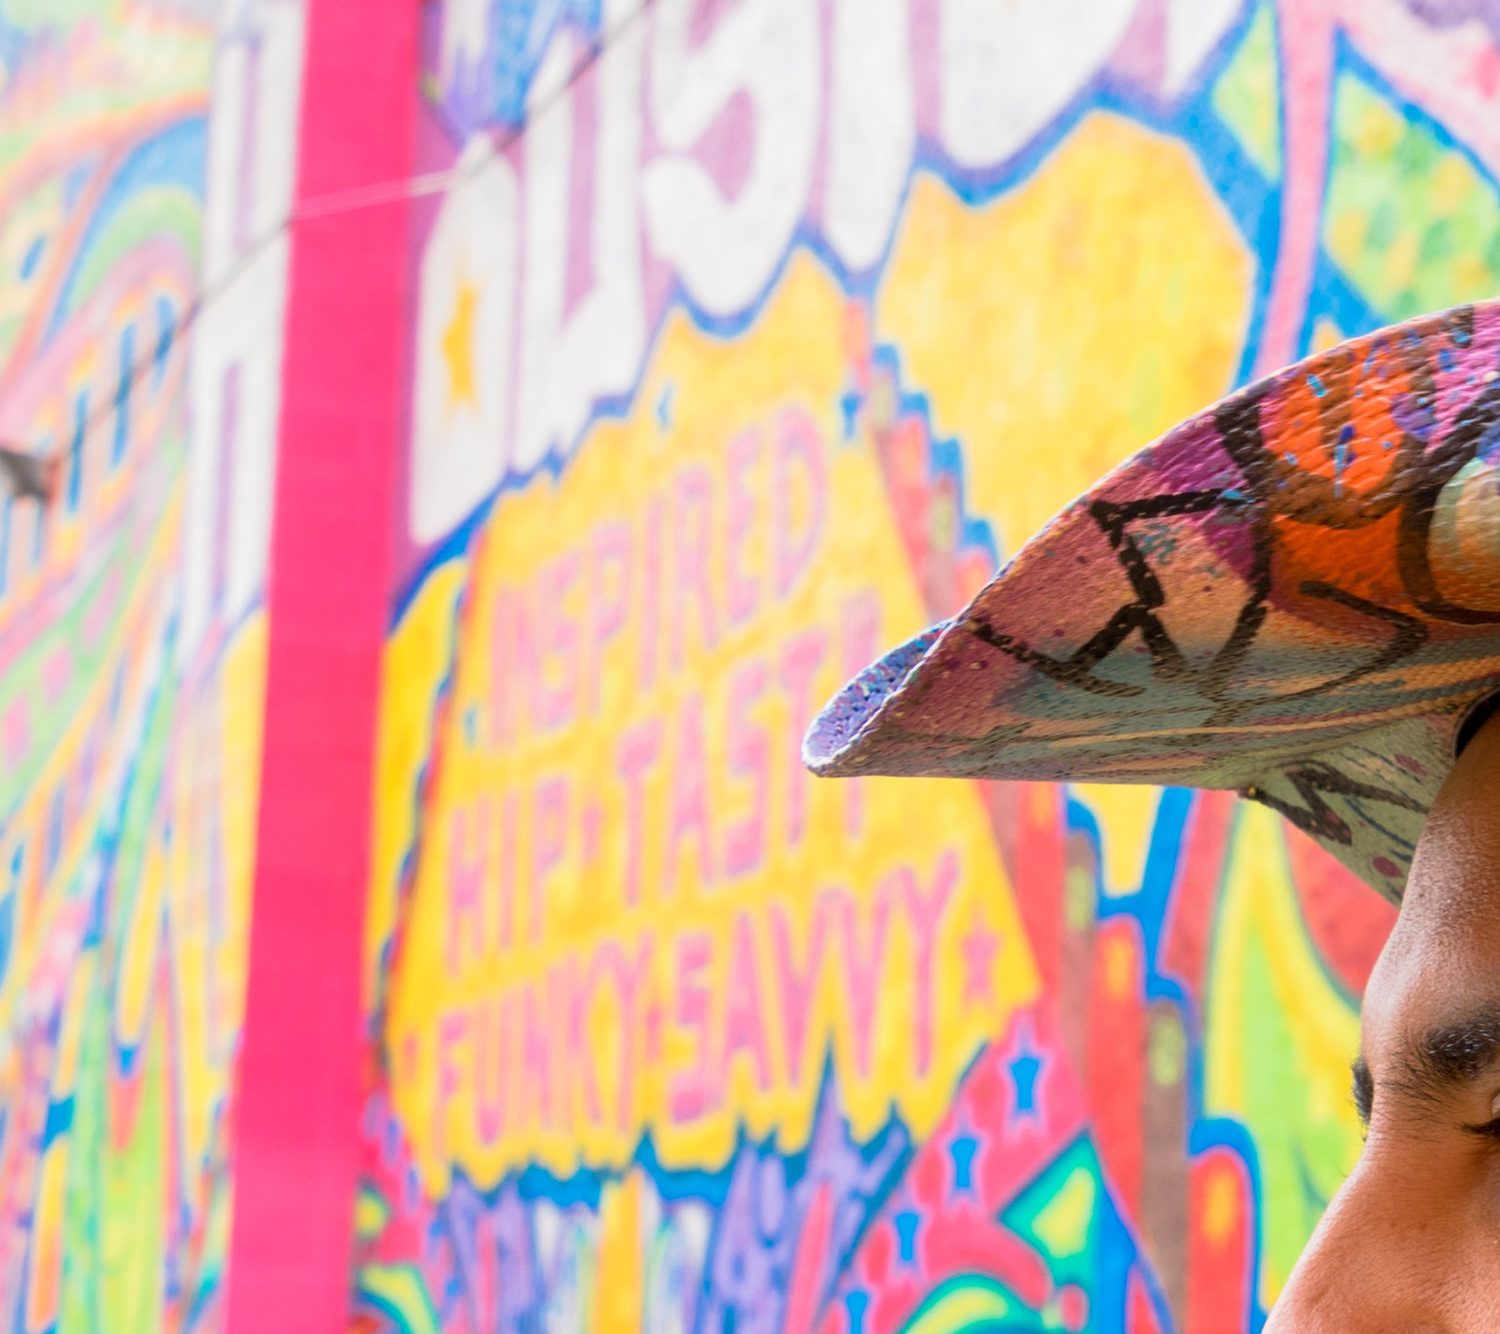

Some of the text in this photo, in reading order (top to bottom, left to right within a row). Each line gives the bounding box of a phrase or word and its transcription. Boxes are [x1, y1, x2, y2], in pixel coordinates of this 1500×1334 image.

[487, 407, 825, 750] INSPIRED
[431, 848, 961, 1172] FUNKY SAVVY
